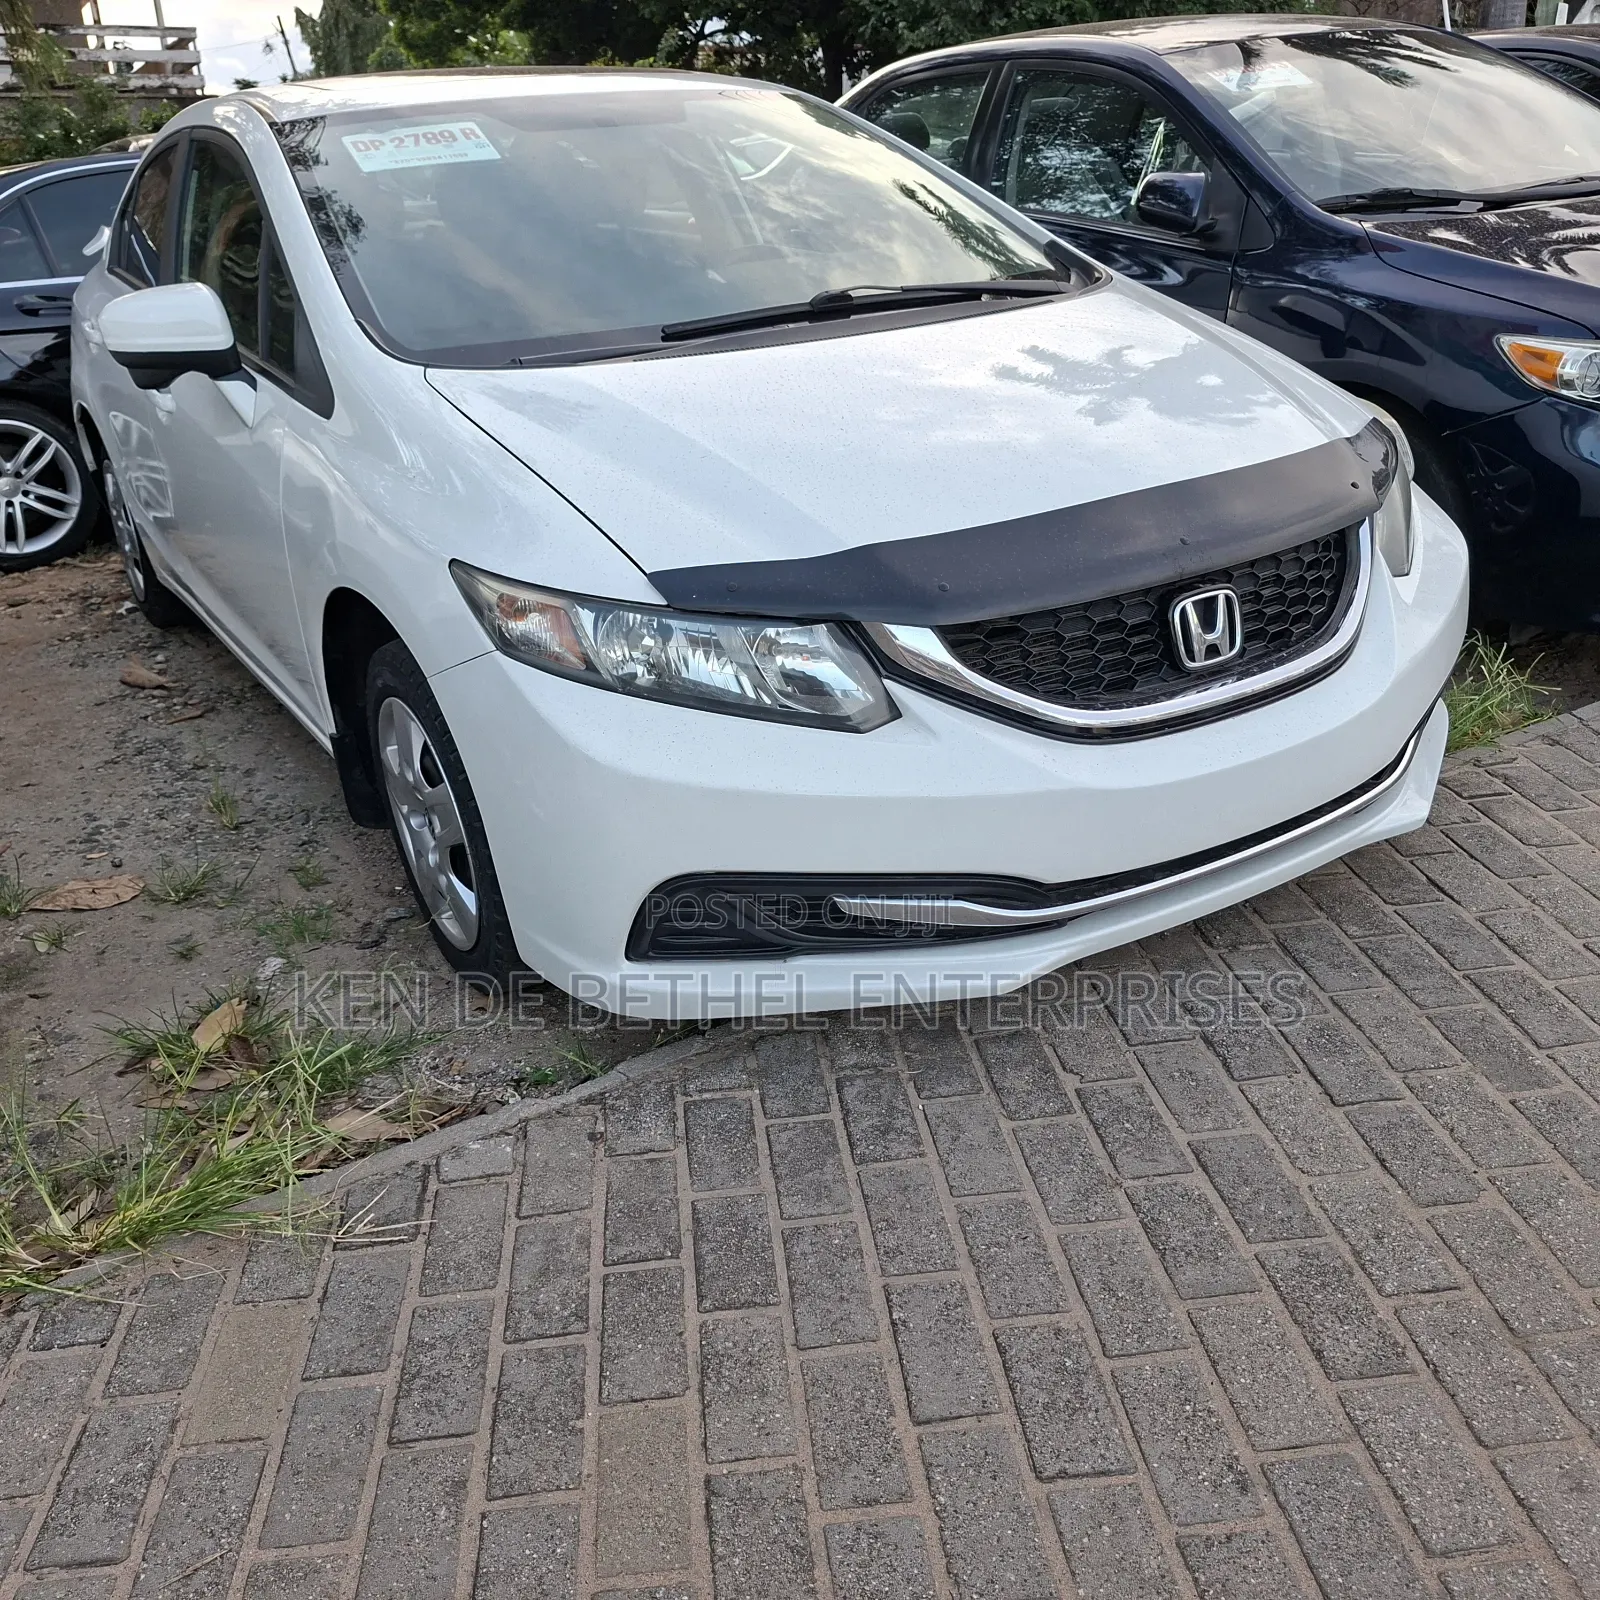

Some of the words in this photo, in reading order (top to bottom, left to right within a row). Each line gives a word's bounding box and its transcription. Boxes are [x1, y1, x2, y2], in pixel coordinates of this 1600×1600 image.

[351, 140, 385, 153] DP
[390, 130, 458, 149] 2789
[460, 128, 480, 140] R
